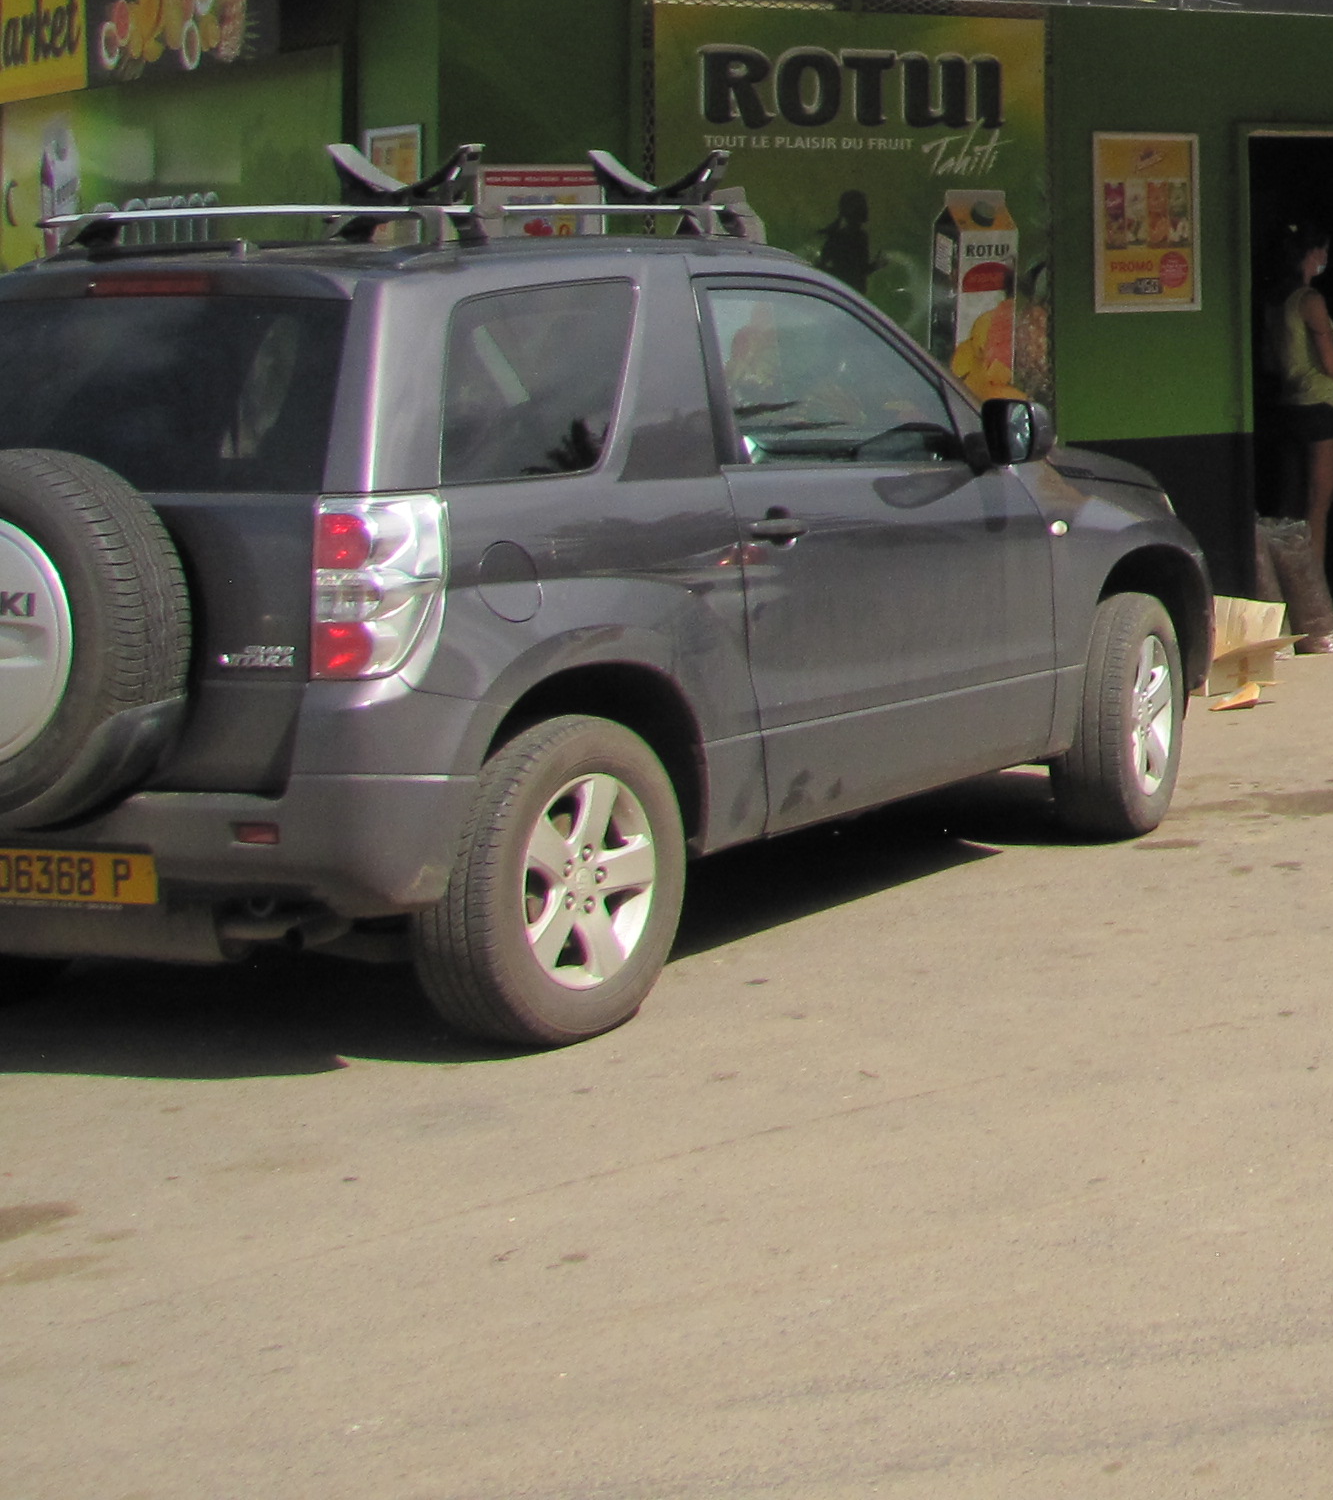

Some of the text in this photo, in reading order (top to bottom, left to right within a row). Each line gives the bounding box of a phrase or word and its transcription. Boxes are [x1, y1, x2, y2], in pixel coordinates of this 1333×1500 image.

[697, 43, 1006, 130] ROTUI
[703, 134, 914, 150] TOUT LE PLAISIR DU FRUIT
[922, 117, 1014, 177] Tahiti
[965, 244, 1010, 257] ROTUI
[1110, 261, 1153, 272] PROMO
[112, 859, 132, 898] P
